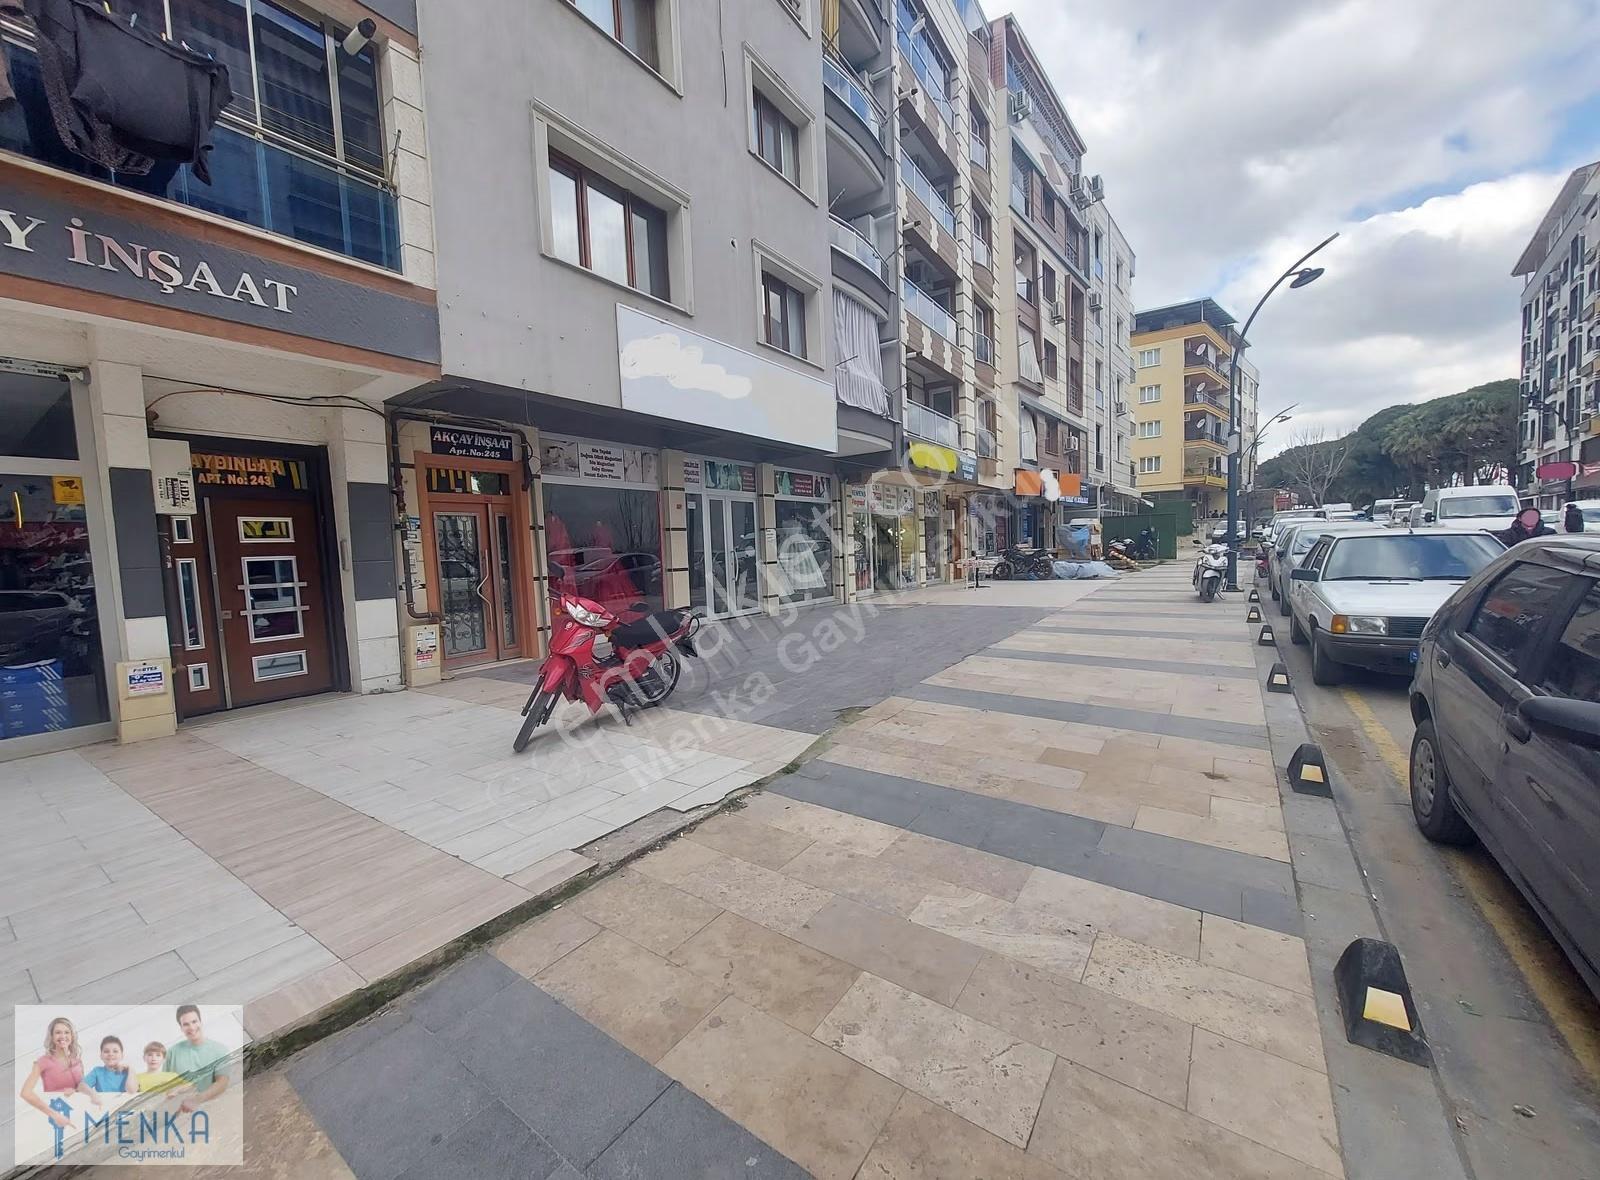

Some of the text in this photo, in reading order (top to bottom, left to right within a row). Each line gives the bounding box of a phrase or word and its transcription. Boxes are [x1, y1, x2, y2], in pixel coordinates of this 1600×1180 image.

[65, 217, 298, 314] İNŞAAT
[433, 430, 512, 449] AKÇAY İNŞAAT
[198, 472, 225, 484] APT.
[250, 475, 271, 486] 243
